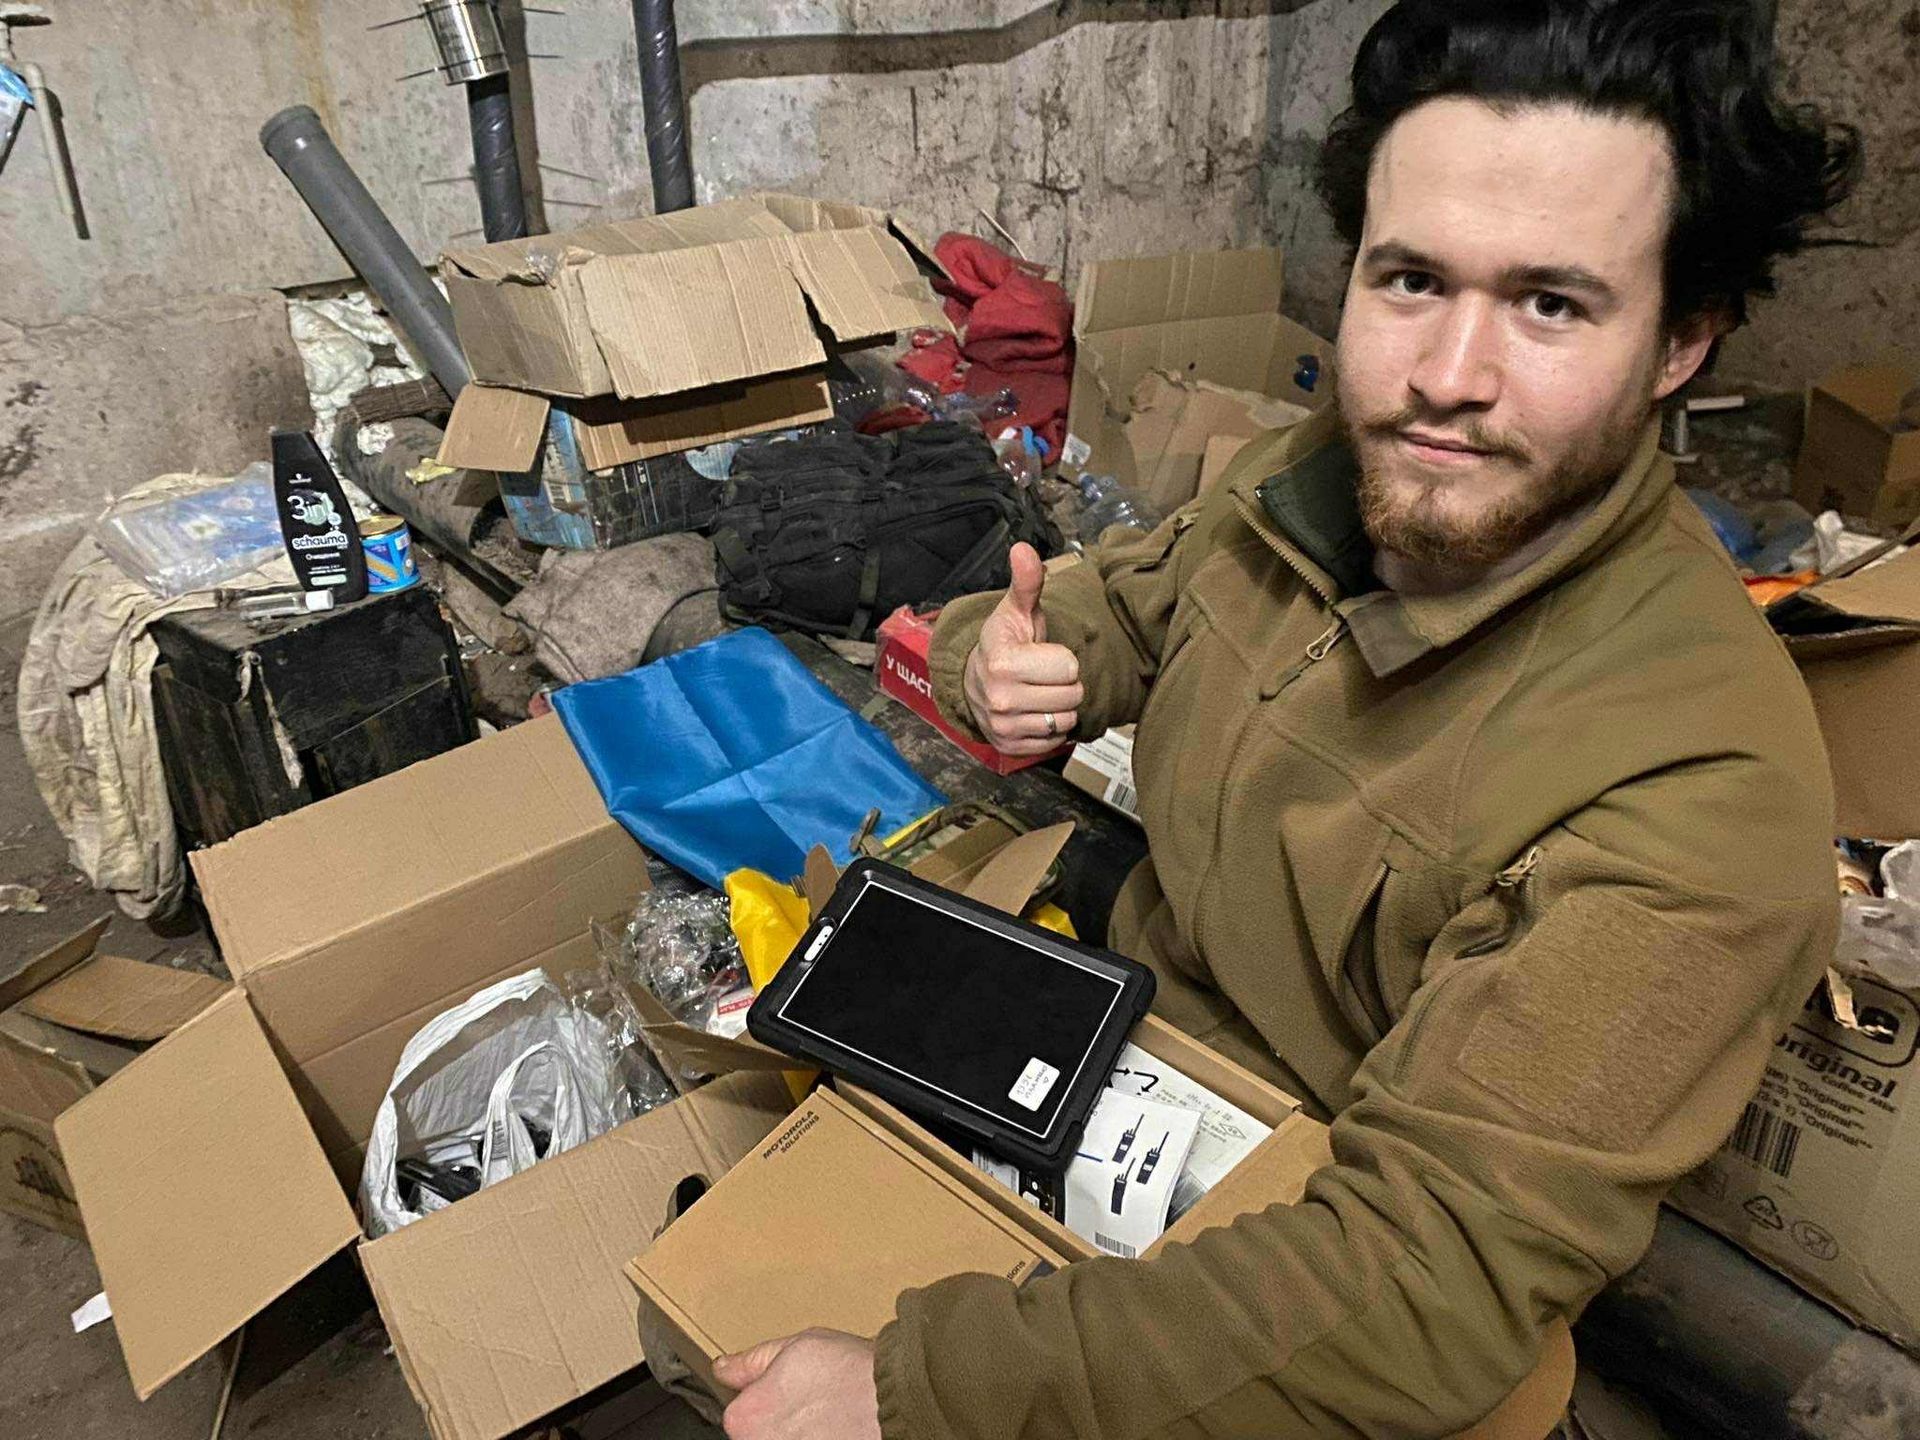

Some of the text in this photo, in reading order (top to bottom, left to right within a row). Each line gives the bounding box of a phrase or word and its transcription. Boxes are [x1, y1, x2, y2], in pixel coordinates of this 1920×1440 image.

[293, 534, 346, 548] schauma
[886, 653, 932, 698] У ЩАСТ
[763, 1110, 814, 1159] MOTOROLA
[780, 1114, 820, 1153] SOLUTIONS
